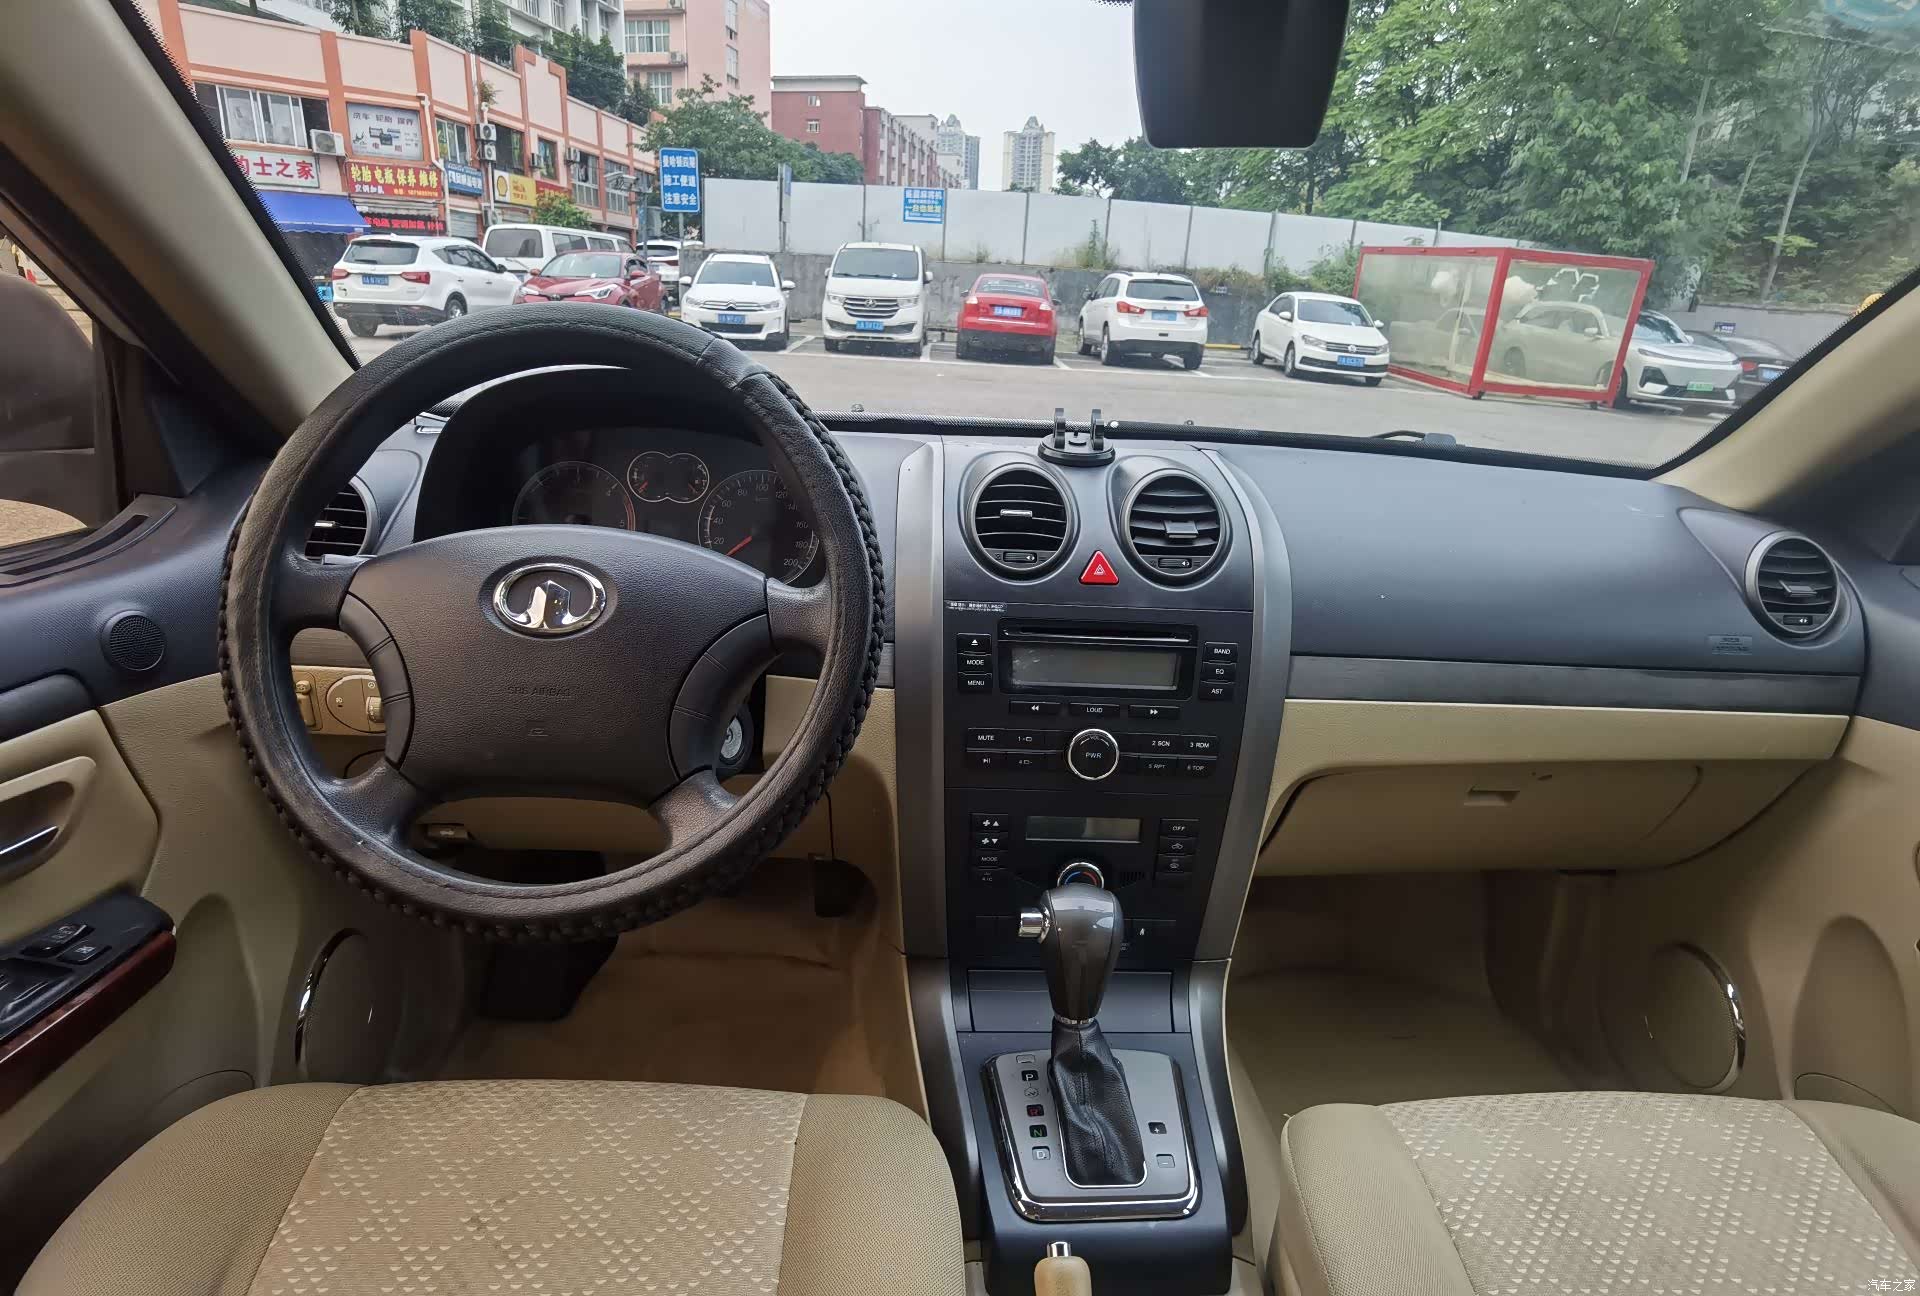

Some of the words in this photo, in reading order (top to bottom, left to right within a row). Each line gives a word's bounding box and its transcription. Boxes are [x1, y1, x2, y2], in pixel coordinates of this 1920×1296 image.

[351, 163, 372, 183] 轮胎
[374, 165, 396, 185] 电瓶
[397, 167, 417, 187] 保养
[419, 170, 439, 189] 维修
[664, 191, 697, 206] 注意安全
[755, 483, 768, 491] 100
[737, 488, 748, 497] 80
[776, 490, 788, 499] 120
[722, 499, 732, 508] 60
[713, 517, 724, 525] 40
[796, 521, 808, 529] 160
[713, 536, 725, 545] 20
[796, 540, 808, 549] 180
[783, 558, 799, 567] 200
[1213, 647, 1231, 655] BAND
[966, 658, 985, 667] MODE
[1215, 667, 1225, 676] EQ
[967, 679, 985, 687] MENU
[1210, 687, 1223, 695] AST
[1086, 706, 1103, 714] LOUD
[977, 734, 995, 742] MUTE
[1157, 740, 1171, 748] SCN
[1195, 741, 1210, 749] RDM
[1085, 751, 1102, 759] PWR
[1192, 764, 1205, 772] TOP
[1025, 1073, 1034, 1081] P
[1030, 1107, 1039, 1116] R
[1033, 1129, 1043, 1137] N
[1036, 1150, 1046, 1158] D
